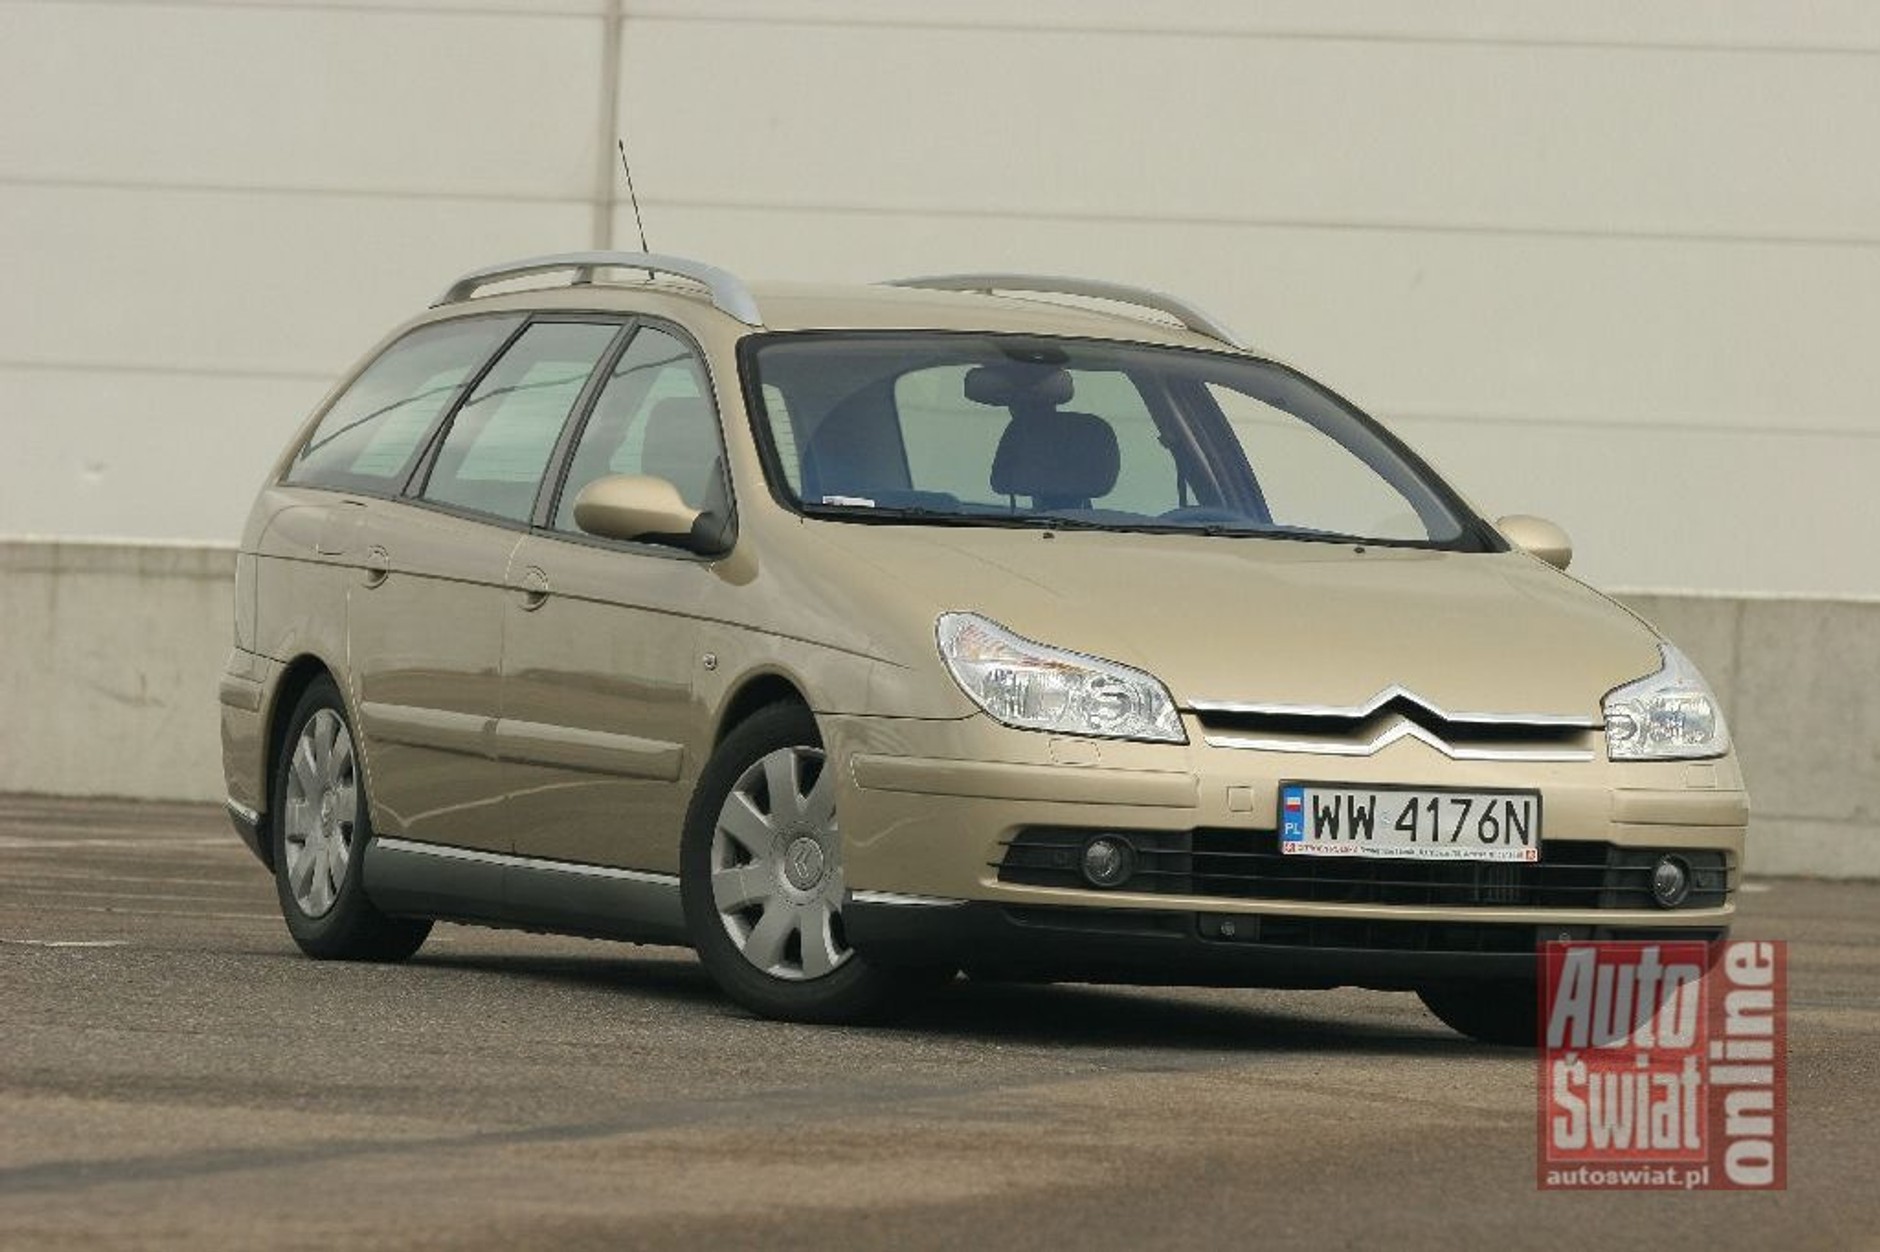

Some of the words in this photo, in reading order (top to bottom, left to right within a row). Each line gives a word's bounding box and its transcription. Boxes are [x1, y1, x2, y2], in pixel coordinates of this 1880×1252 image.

[1284, 822, 1302, 835] PL
[1312, 795, 1376, 840] WW
[1394, 797, 1531, 845] 4176N
